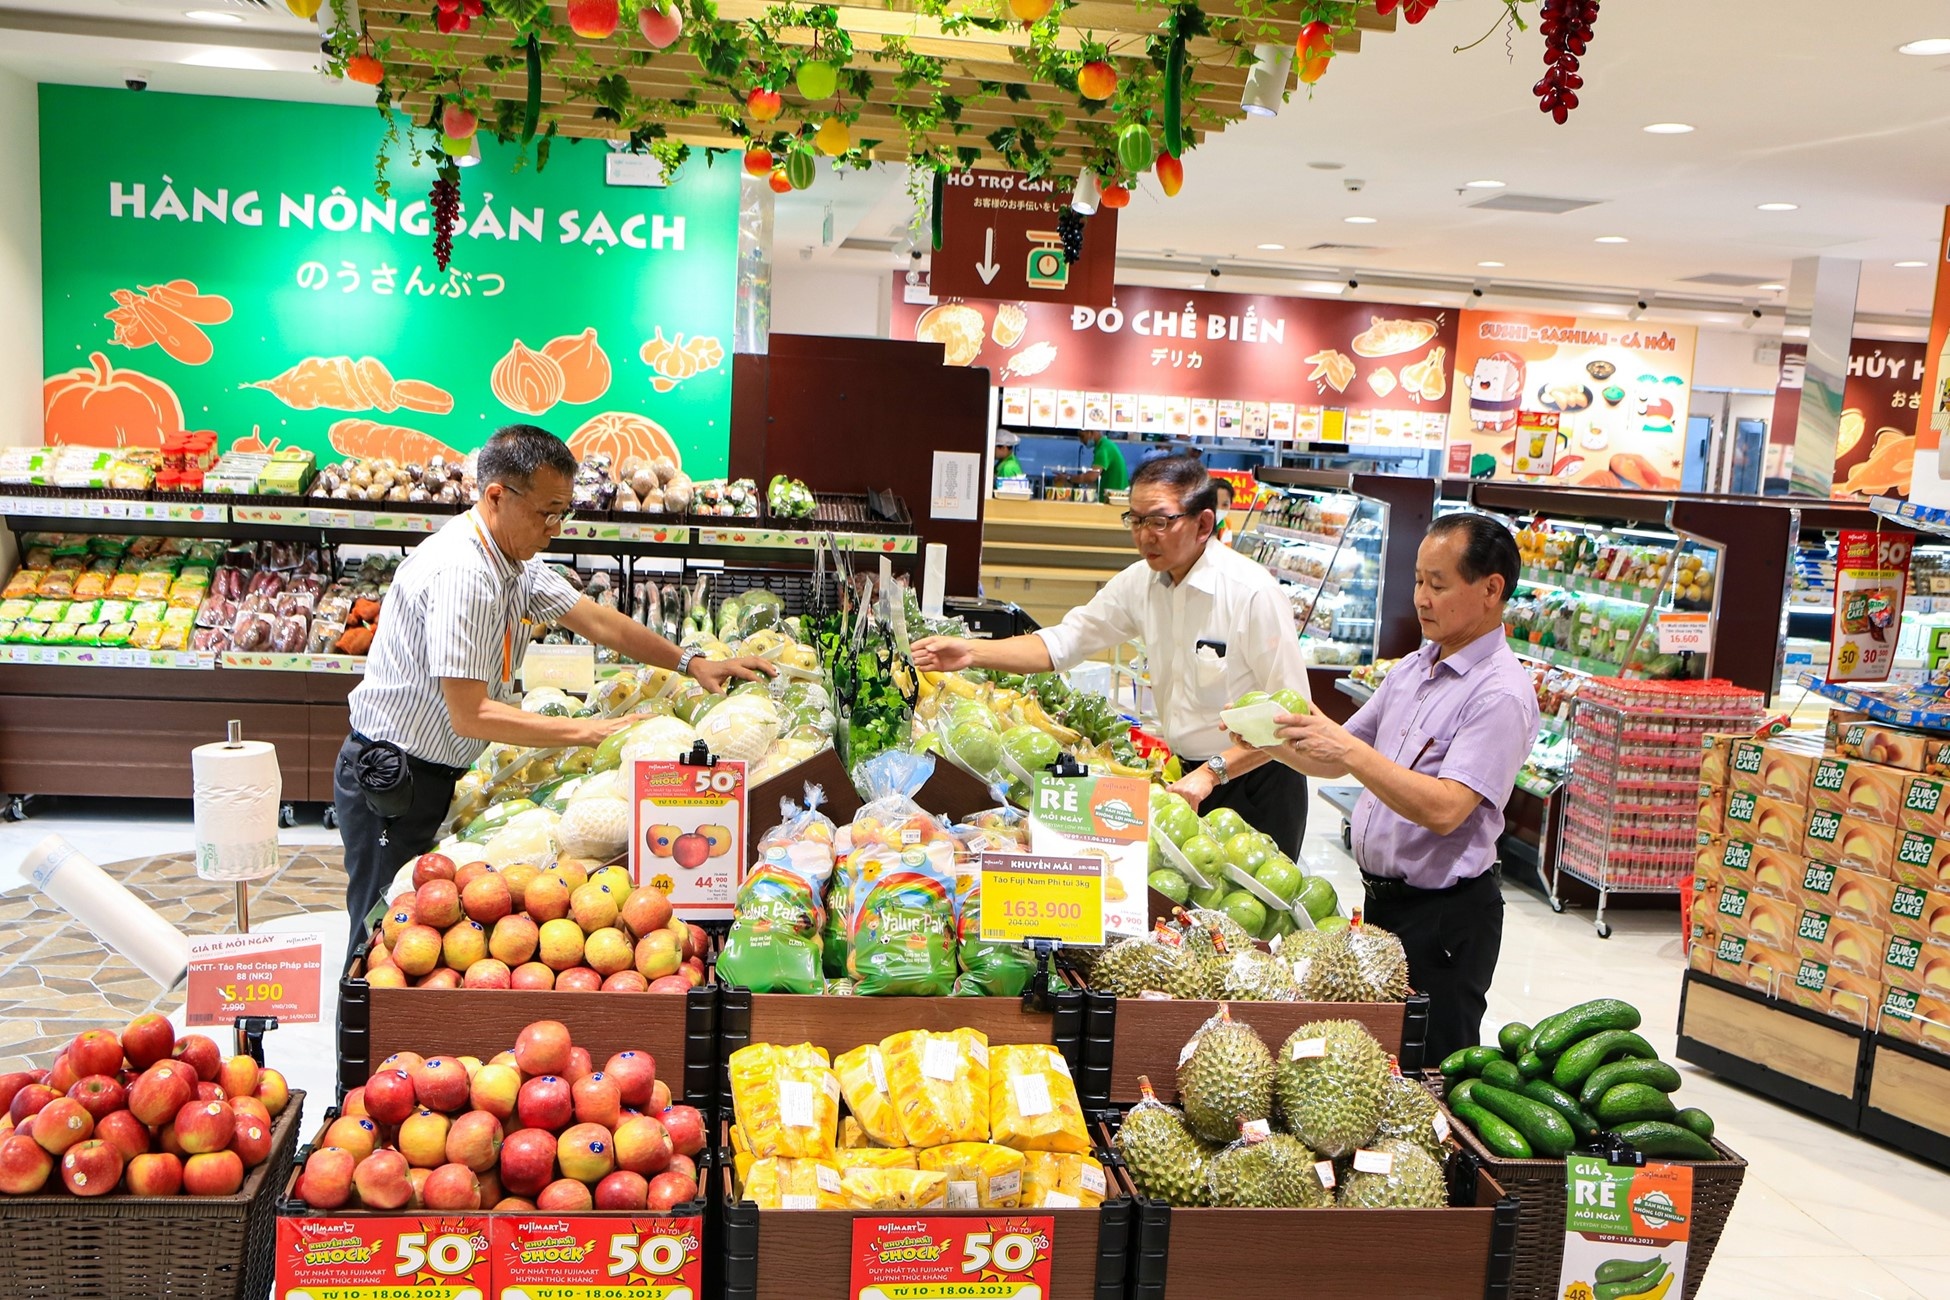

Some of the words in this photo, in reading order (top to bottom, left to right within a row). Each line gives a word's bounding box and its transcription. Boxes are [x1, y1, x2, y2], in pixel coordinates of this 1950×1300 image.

[947, 170, 974, 187] HỖ
[978, 175, 1014, 193] TRỢ
[974, 197, 1068, 213] お客様のお手伝いをし
[109, 174, 262, 227] HÀNG
[279, 185, 430, 237] NÔNG
[560, 210, 685, 256] SẠCH
[297, 262, 505, 298] のうさんぶつ
[1132, 301, 1198, 339] CHẾ
[1207, 305, 1286, 345] BIẾN
[1481, 324, 1527, 339] SUSHI
[1540, 328, 1607, 345] SASHIMI
[1620, 332, 1641, 348] CÁ
[1150, 347, 1203, 369] デリカ
[1846, 349, 1906, 379] HỦY
[1912, 360, 1925, 380] H
[1891, 390, 1922, 409] おさ
[1670, 634, 1699, 643] 16.600
[1863, 649, 1877, 663] 30
[1738, 750, 1761, 761] EURO
[1735, 760, 1759, 771] CAKE
[1819, 767, 1844, 779] EURO
[1815, 776, 1842, 788] CAKE
[1040, 784, 1079, 812] RẺ
[1910, 787, 1939, 800] EURO
[1731, 798, 1754, 809] EURO
[1906, 797, 1936, 810] CAKE
[1040, 813, 1059, 821] MỖI
[1060, 815, 1083, 824] NGÀY
[1729, 808, 1752, 820] CAKE
[1812, 816, 1838, 829] EURO
[1810, 827, 1836, 839] CAKE
[1727, 846, 1750, 858] EURO
[1902, 840, 1932, 853] EURO
[1724, 856, 1748, 868] CAKE
[1899, 851, 1929, 863] CAKE
[1010, 858, 1051, 870] KHUYẾN
[1052, 860, 1073, 871] MÃI
[1807, 869, 1833, 881] EURO
[694, 876, 713, 888] 44
[1010, 876, 1026, 886] Fuji
[1028, 877, 1045, 886] Nam
[1048, 878, 1061, 886] Phi
[1075, 879, 1090, 889] 3kg
[1805, 879, 1830, 891] CAKE
[830, 891, 847, 910] alu
[773, 901, 798, 922] Pak
[1003, 900, 1082, 919] 163.900
[880, 908, 920, 931] Value
[922, 913, 944, 935] Pak
[1008, 918, 1039, 927] 204.000
[192, 944, 209, 954] GIÁ
[212, 940, 224, 951] RẺ
[225, 937, 246, 949] MỖI
[248, 935, 275, 945] NGÀY
[190, 963, 216, 972] NKTT-
[219, 962, 234, 971] Táo
[236, 961, 253, 971] Red
[255, 961, 278, 971] Crisp
[280, 960, 301, 970] Pháp
[303, 961, 320, 969] size
[236, 973, 247, 981] 88
[248, 972, 273, 981] (NK2)
[225, 983, 283, 1002] 5.190
[221, 1003, 246, 1012] 7.990
[1575, 1161, 1602, 1176] GIÁ
[1574, 1173, 1616, 1208] RẺ
[1644, 1201, 1657, 1209] BÁN
[1656, 1203, 1672, 1213] HÀNG
[1574, 1209, 1595, 1219] MỖI
[1596, 1212, 1621, 1221] NGÀY
[1634, 1206, 1654, 1216] KHÔNG
[1664, 1213, 1685, 1222] NHUẬN
[303, 1223, 344, 1234] FUJIMART
[519, 1222, 559, 1233] FUJIMART
[879, 1223, 916, 1233] FUJIMART
[1573, 1221, 1599, 1229] EVERYDAY
[1620, 1236, 1654, 1244] 11.06.2023
[305, 1248, 370, 1264] SHOCK
[520, 1247, 584, 1264] SHOCK
[880, 1248, 940, 1264] SHOCK
[312, 1267, 334, 1276] NHẤT
[336, 1269, 349, 1277] TẠI
[527, 1267, 549, 1275] NHẤT
[551, 1268, 563, 1276] TẠI
[886, 1266, 906, 1274] NHẤT
[300, 1276, 329, 1284] HUỲNH
[331, 1275, 352, 1284] THÚC
[354, 1275, 380, 1283] KHÁNG
[516, 1275, 543, 1283] HUỲNH
[546, 1275, 566, 1283] THÚC
[567, 1275, 593, 1283] KHÁNG
[874, 1274, 900, 1282] HUỲNH
[322, 1290, 339, 1299] TỪ
[344, 1290, 360, 1299] 10
[374, 1289, 451, 1298] 18.06.2023
[537, 1289, 553, 1298] TỪ
[557, 1290, 573, 1298] 10
[585, 1289, 662, 1298] 18.06.2023
[894, 1286, 909, 1296] TỪ
[913, 1287, 928, 1295] 10
[940, 1286, 1012, 1295] 18.06.2023
